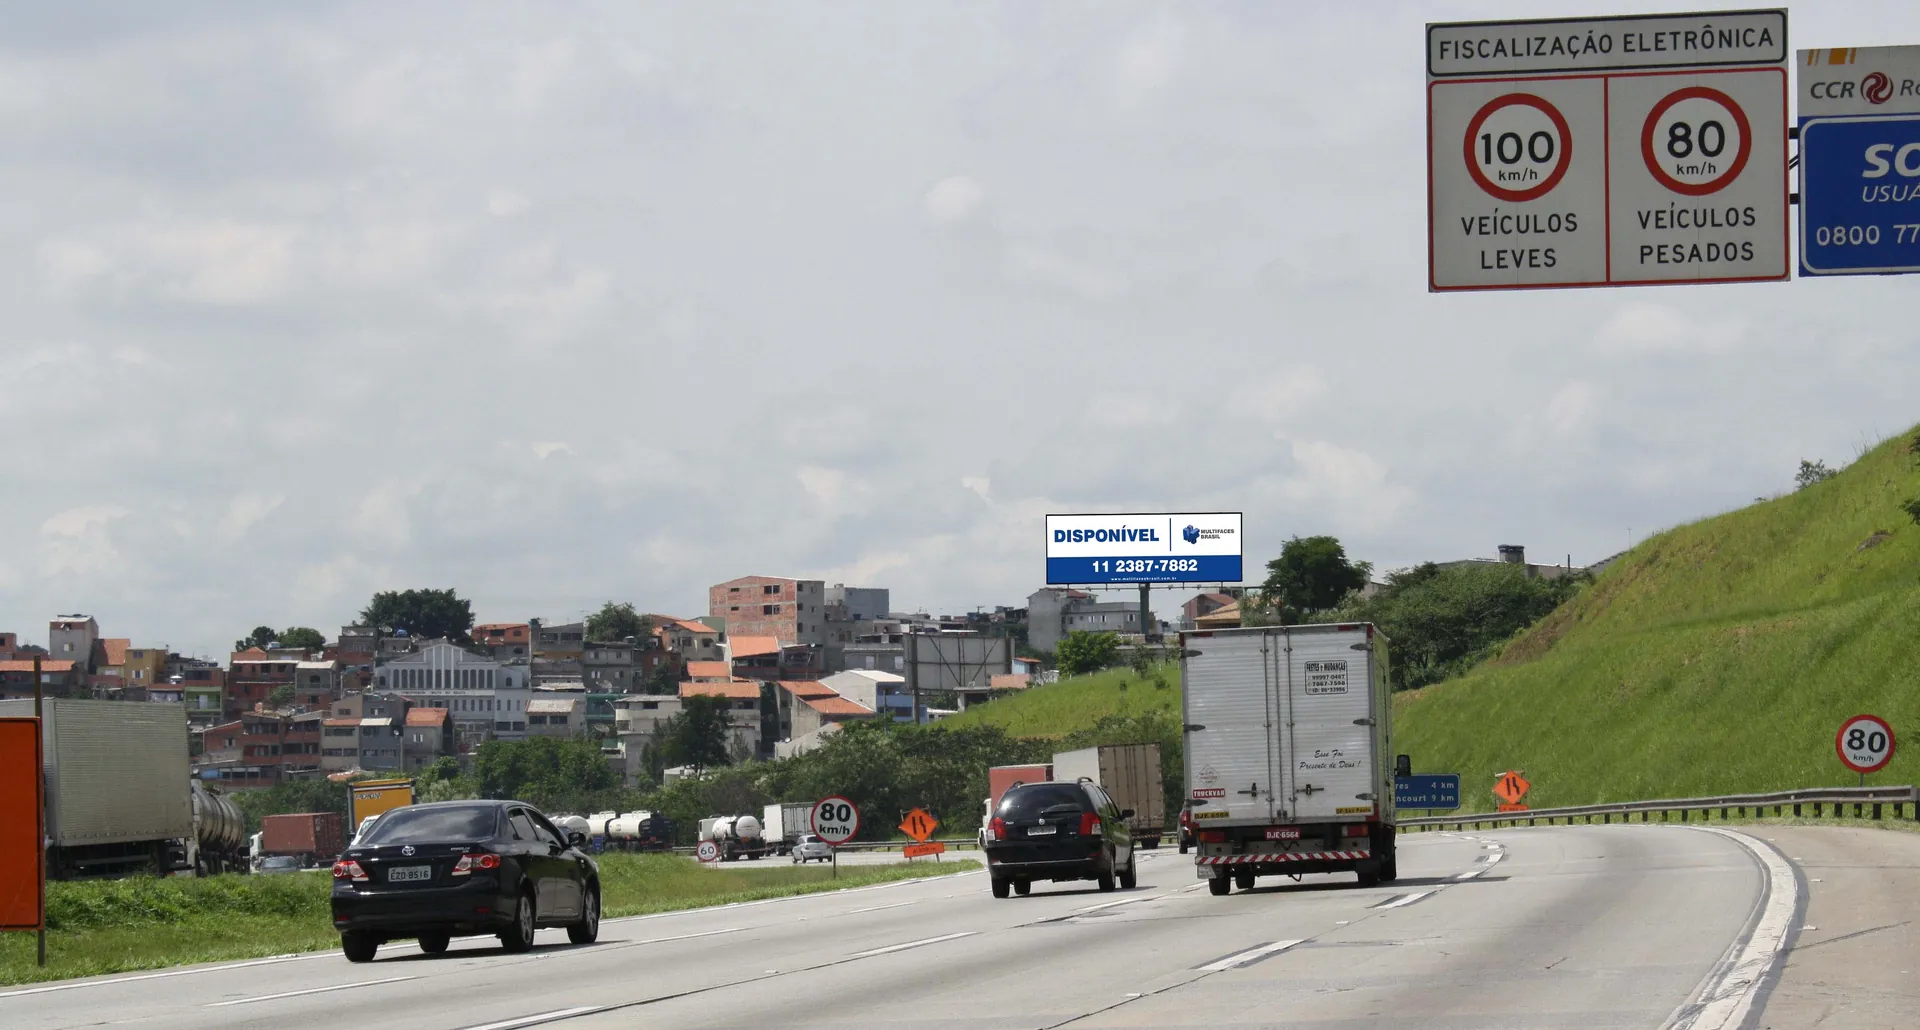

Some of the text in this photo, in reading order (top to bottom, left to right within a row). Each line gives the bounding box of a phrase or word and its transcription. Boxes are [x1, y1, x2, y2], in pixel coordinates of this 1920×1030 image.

[1440, 24, 1774, 60] FISCALIZAÇÃO ELETRÔNICA
[1810, 82, 1855, 99] CCR
[1481, 131, 1554, 165] 100
[1667, 120, 1725, 158] 80
[1498, 167, 1538, 181] km/h
[1676, 161, 1716, 175] km/h
[1461, 207, 1577, 236] VEÍCULOS
[1637, 201, 1756, 230] VEÍCULOS
[1816, 225, 1880, 246] 0800
[1481, 248, 1557, 269] LEVES
[1640, 241, 1754, 264] PESADOS
[1054, 524, 1159, 543] DISPONÍVEL
[1092, 559, 1198, 573] 11 2387-7882
[1847, 728, 1886, 754] 80
[1853, 753, 1874, 762] km/h
[1431, 781, 1437, 789] 4
[1441, 781, 1455, 789] km
[1431, 794, 1437, 802] 9
[1441, 794, 1455, 802] km
[820, 802, 851, 822] 80
[819, 824, 850, 835] km/h
[700, 846, 715, 855] 60
